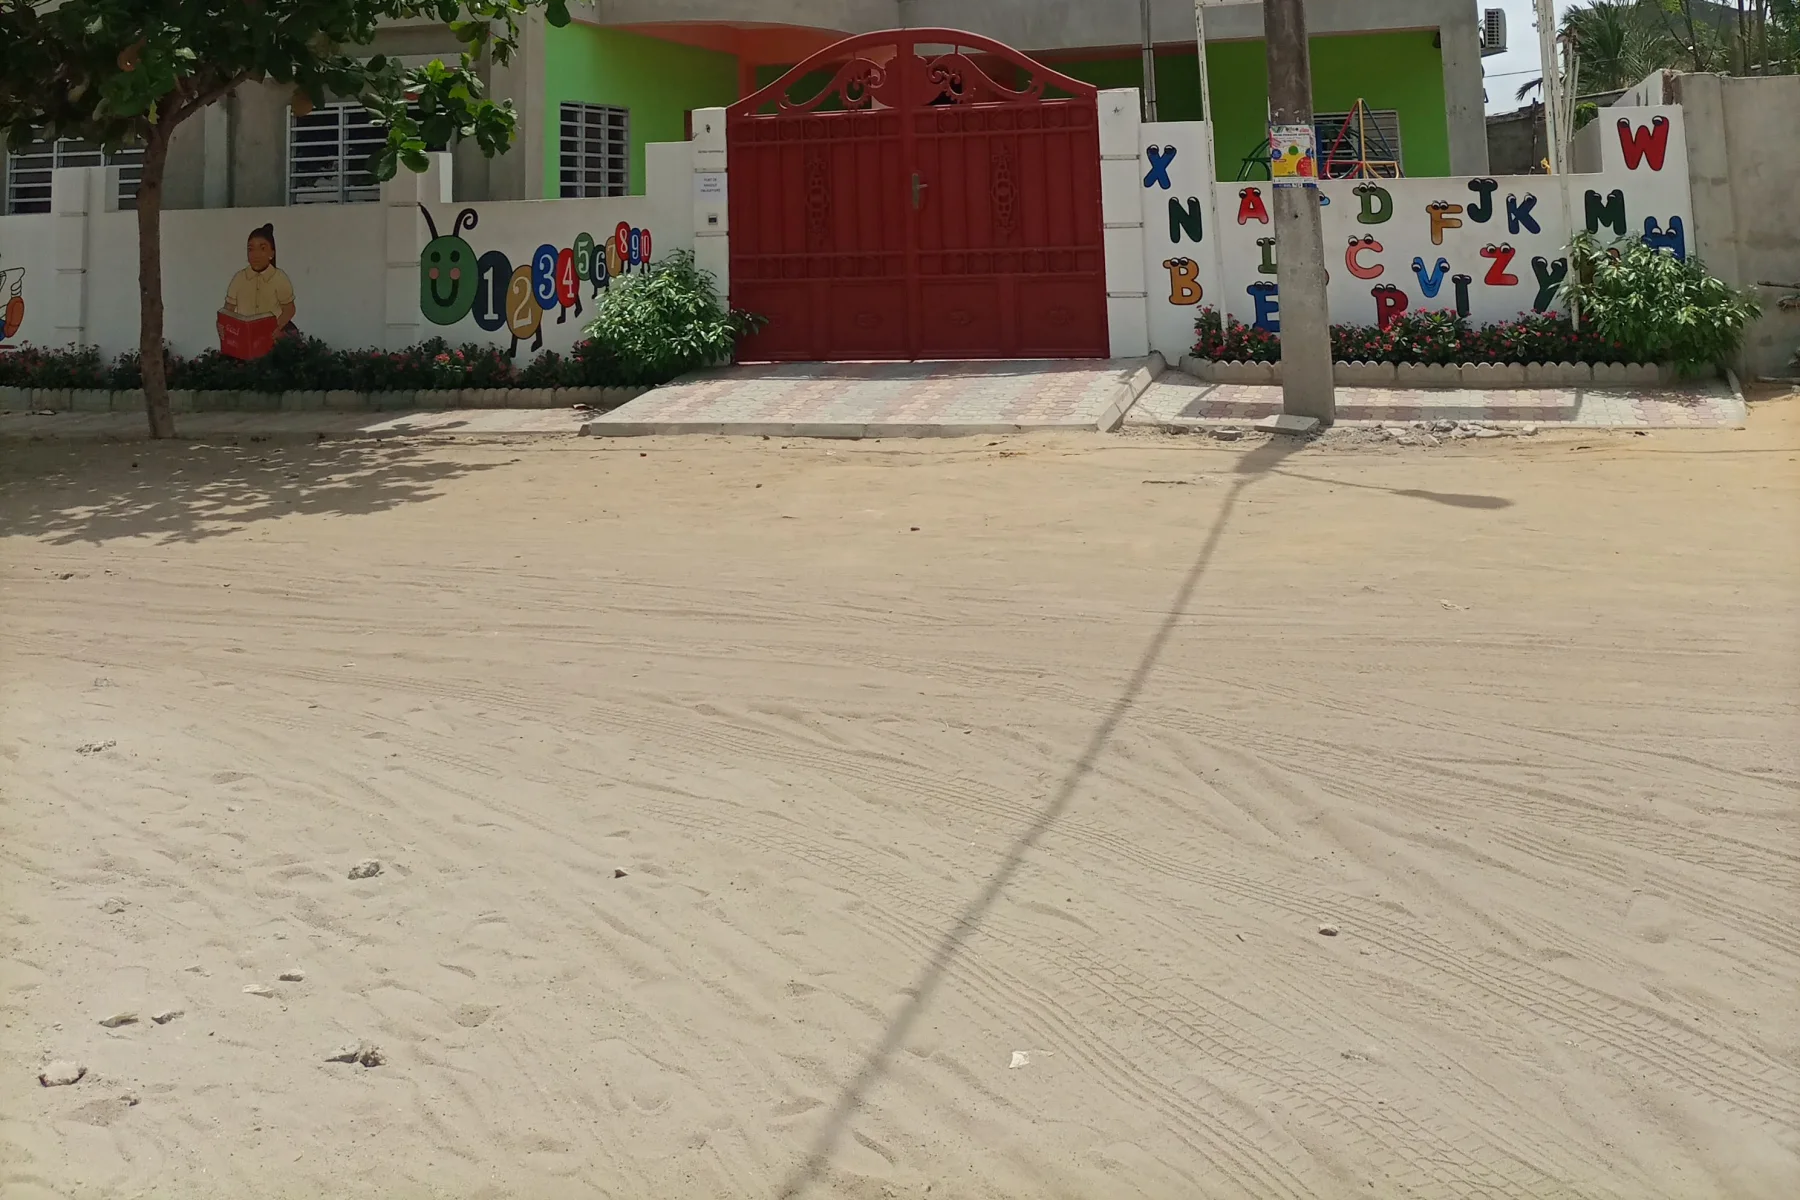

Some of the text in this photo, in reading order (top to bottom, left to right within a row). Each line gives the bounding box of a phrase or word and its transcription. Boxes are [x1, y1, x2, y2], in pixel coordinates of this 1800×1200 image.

[1617, 115, 1669, 171] W
[1143, 144, 1177, 190] X
[1168, 196, 1203, 243] N
[1237, 187, 1269, 225] A
[1352, 181, 1393, 224] D
[1425, 201, 1463, 245] F
[1466, 178, 1498, 223] J
[1506, 192, 1541, 234] K
[1585, 189, 1627, 236] M
[483, 228, 649, 329] 1 2 3 4 5 6 7 8 9 10
[1345, 233, 1385, 280] C
[1411, 257, 1450, 298] V
[1480, 242, 1519, 285] Z
[1162, 257, 1203, 305] B
[1531, 256, 1568, 314] Y
[1371, 283, 1409, 331] P
